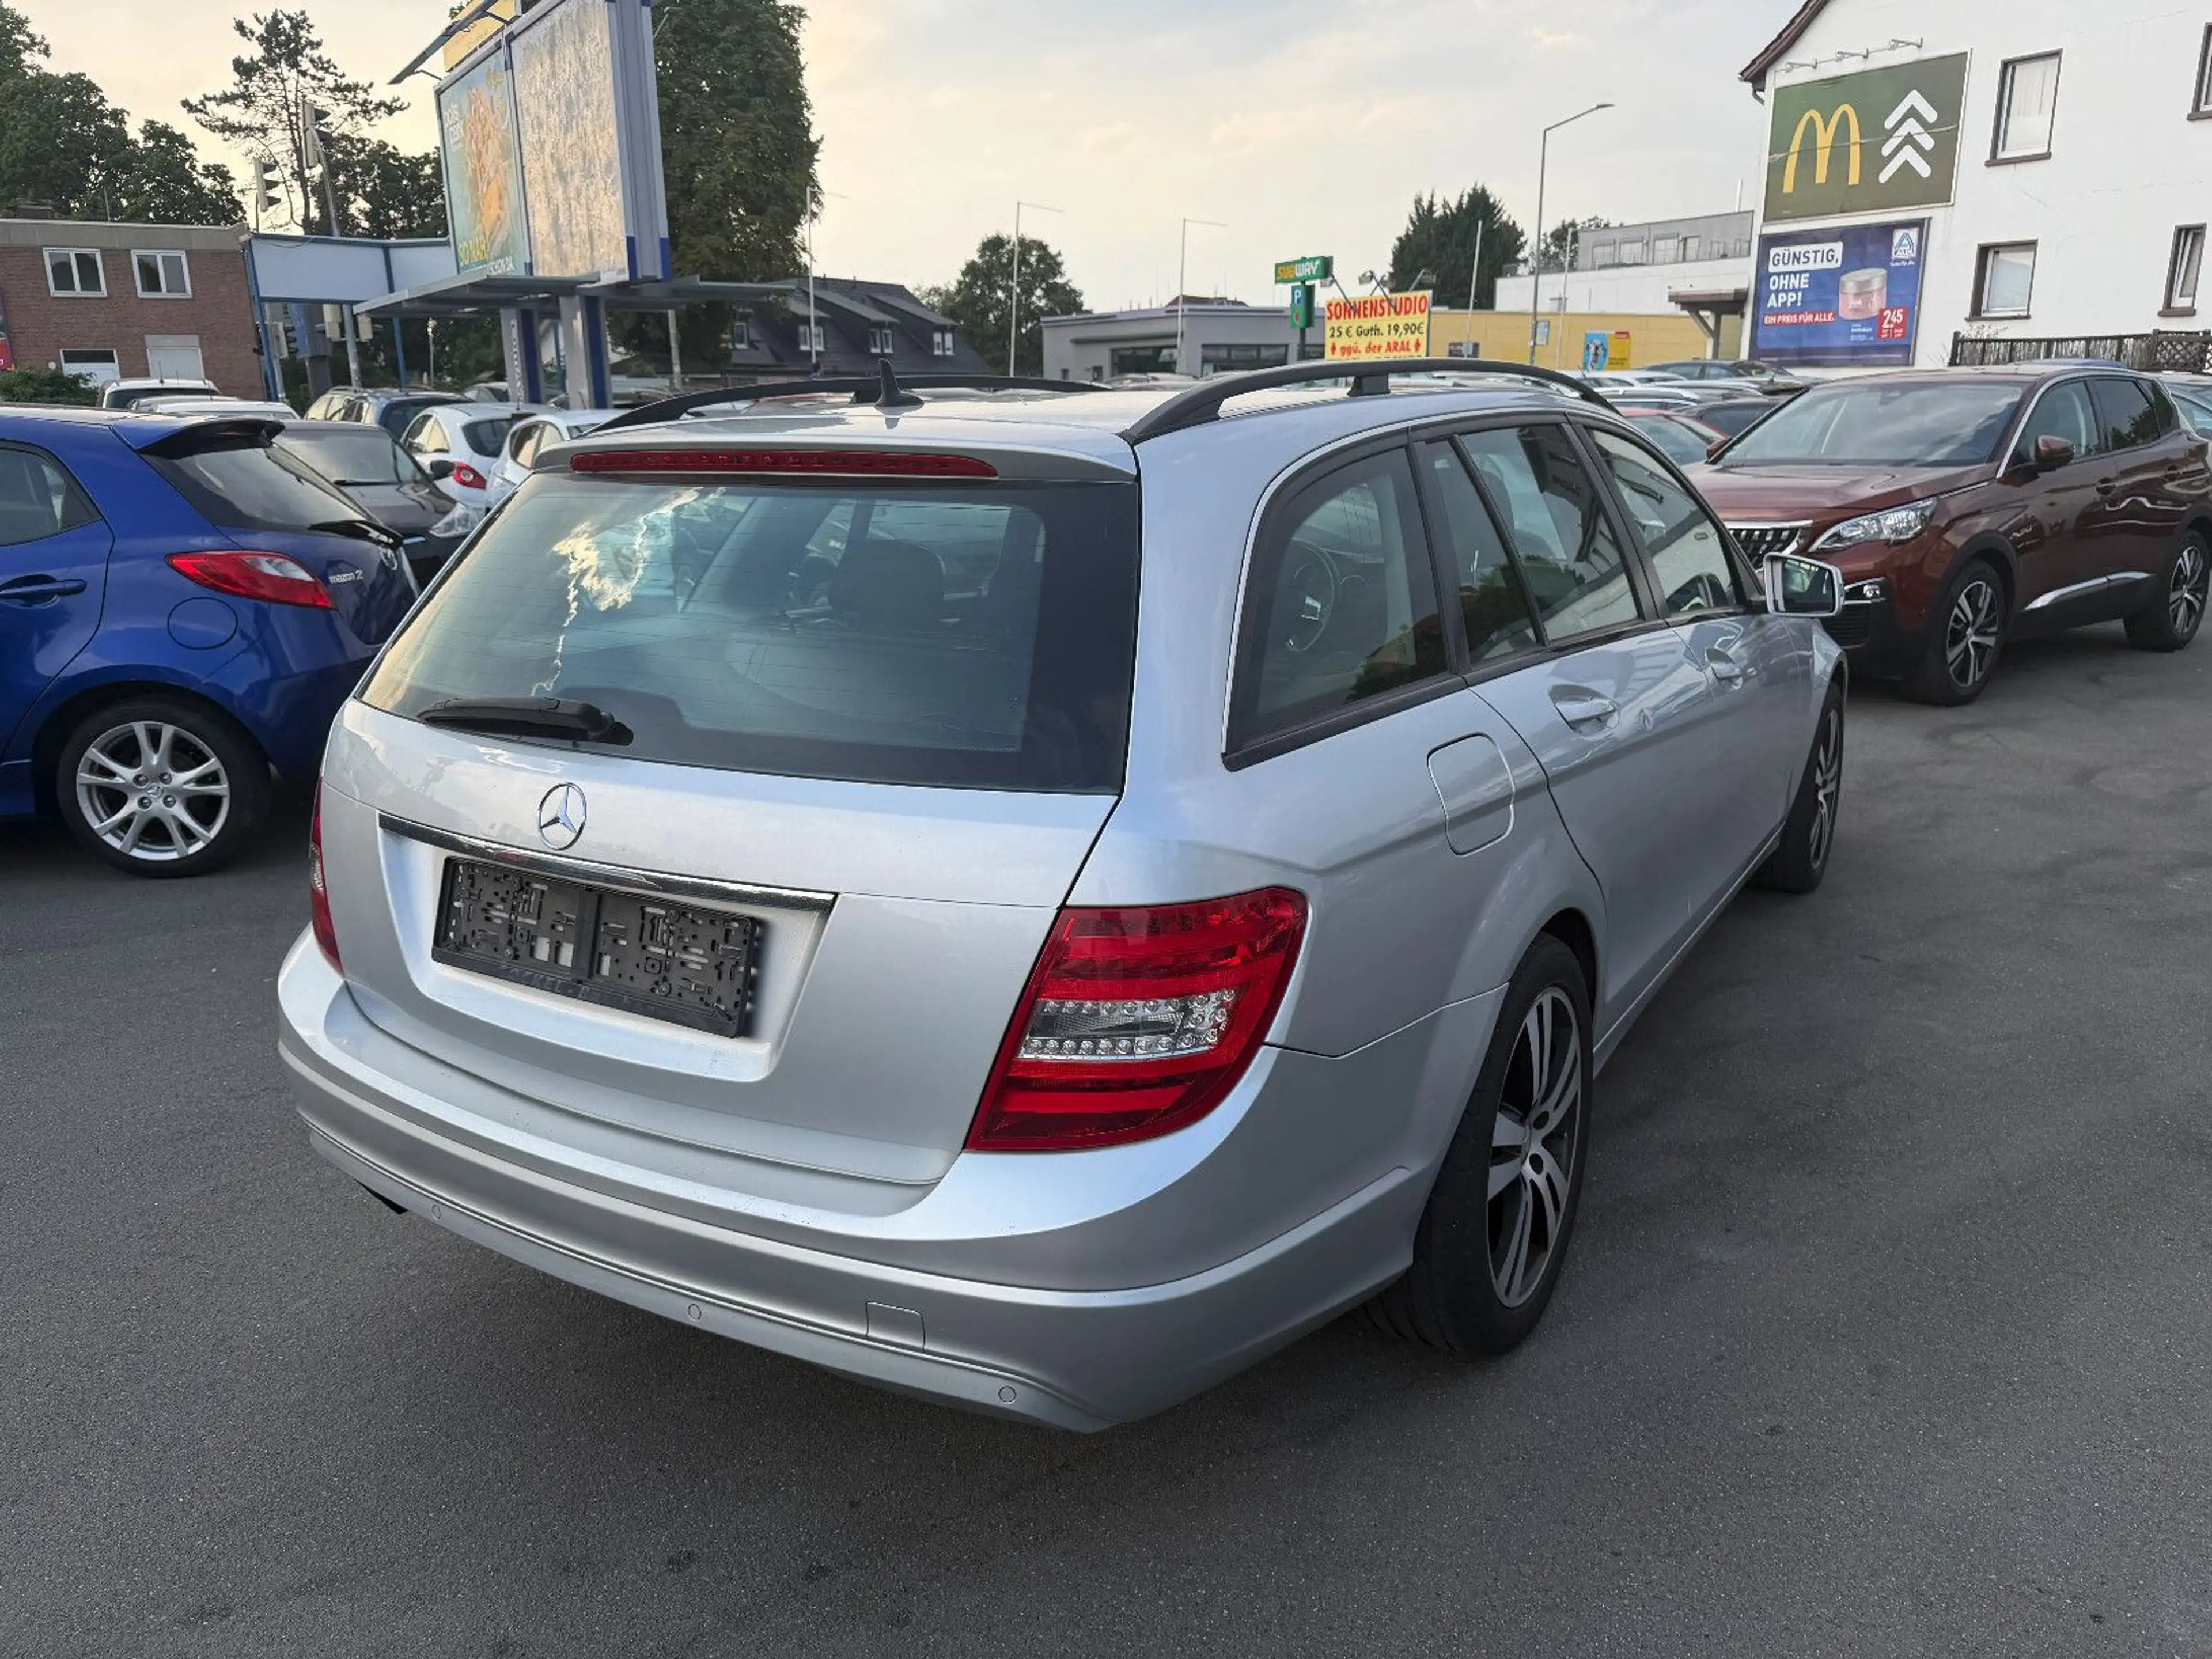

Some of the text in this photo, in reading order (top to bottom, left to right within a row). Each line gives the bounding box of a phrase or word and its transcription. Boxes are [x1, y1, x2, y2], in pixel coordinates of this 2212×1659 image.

[1772, 248, 1838, 266] GÜNSTIG,
[1278, 259, 1321, 279] SUBWAY
[1770, 273, 1809, 290] OHNE
[1294, 289, 1301, 305] P
[1767, 291, 1802, 308] APP!
[1327, 295, 1427, 320] SONNENSTUDIO
[1330, 322, 1424, 338] 25 € Guth. 19,90€
[1365, 341, 1382, 353] der
[1385, 340, 1411, 353] ARAL
